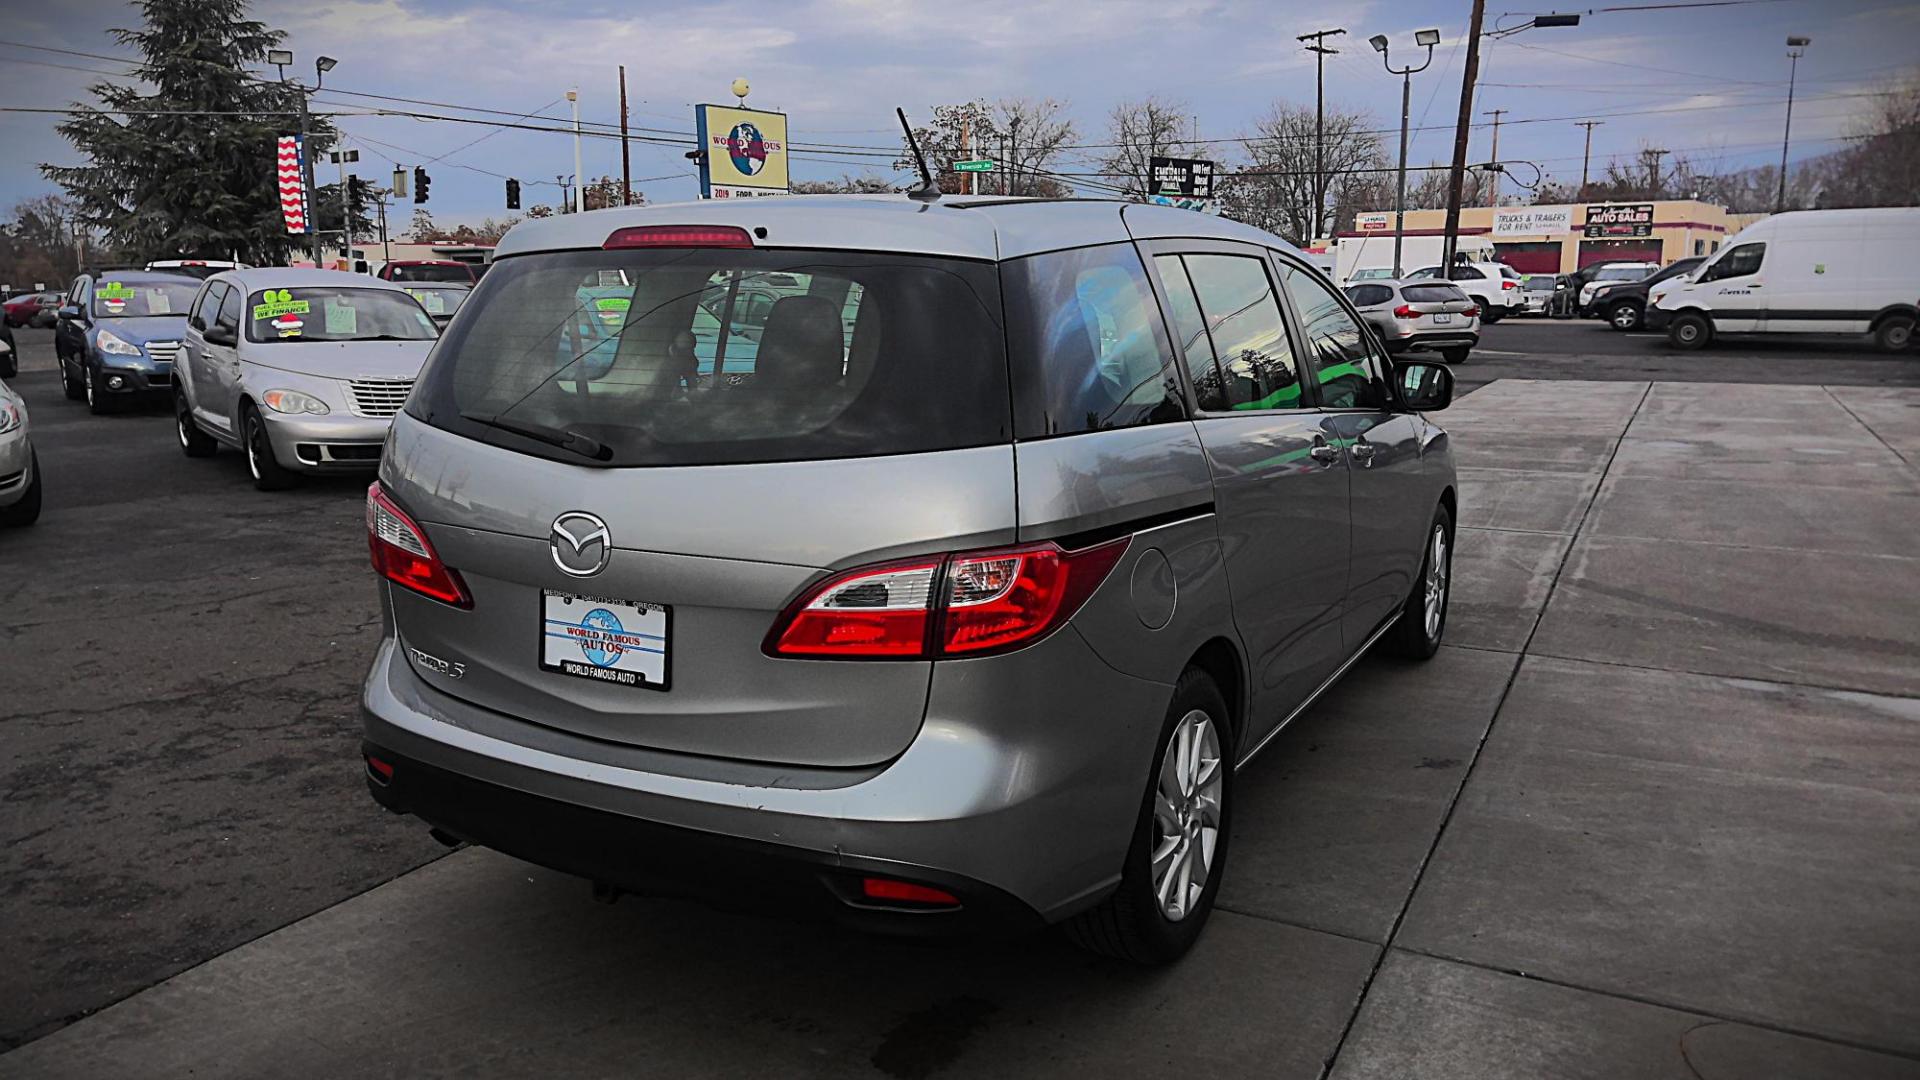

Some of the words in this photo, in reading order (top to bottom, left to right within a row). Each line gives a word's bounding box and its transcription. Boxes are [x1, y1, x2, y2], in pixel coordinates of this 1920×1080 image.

[713, 136, 744, 147] WOD
[1155, 166, 1187, 182] EMERALD
[715, 189, 729, 198] 2019
[1498, 214, 1523, 223] TRUCKS
[1535, 213, 1567, 222] TRAILERS
[1590, 213, 1616, 223] AUTO
[1617, 212, 1649, 222] SALES
[1498, 223, 1512, 231] FOR
[1515, 222, 1533, 230] RENT
[257, 310, 270, 318] WE
[272, 306, 305, 315] FINANCE
[632, 601, 665, 612] OREGON
[566, 627, 599, 639] WORLD
[602, 632, 640, 646] FAMOUS
[582, 639, 624, 655] AUTOS
[566, 663, 589, 676] WORLD
[589, 667, 616, 680] FAMOUS
[616, 671, 635, 684] AUTO
